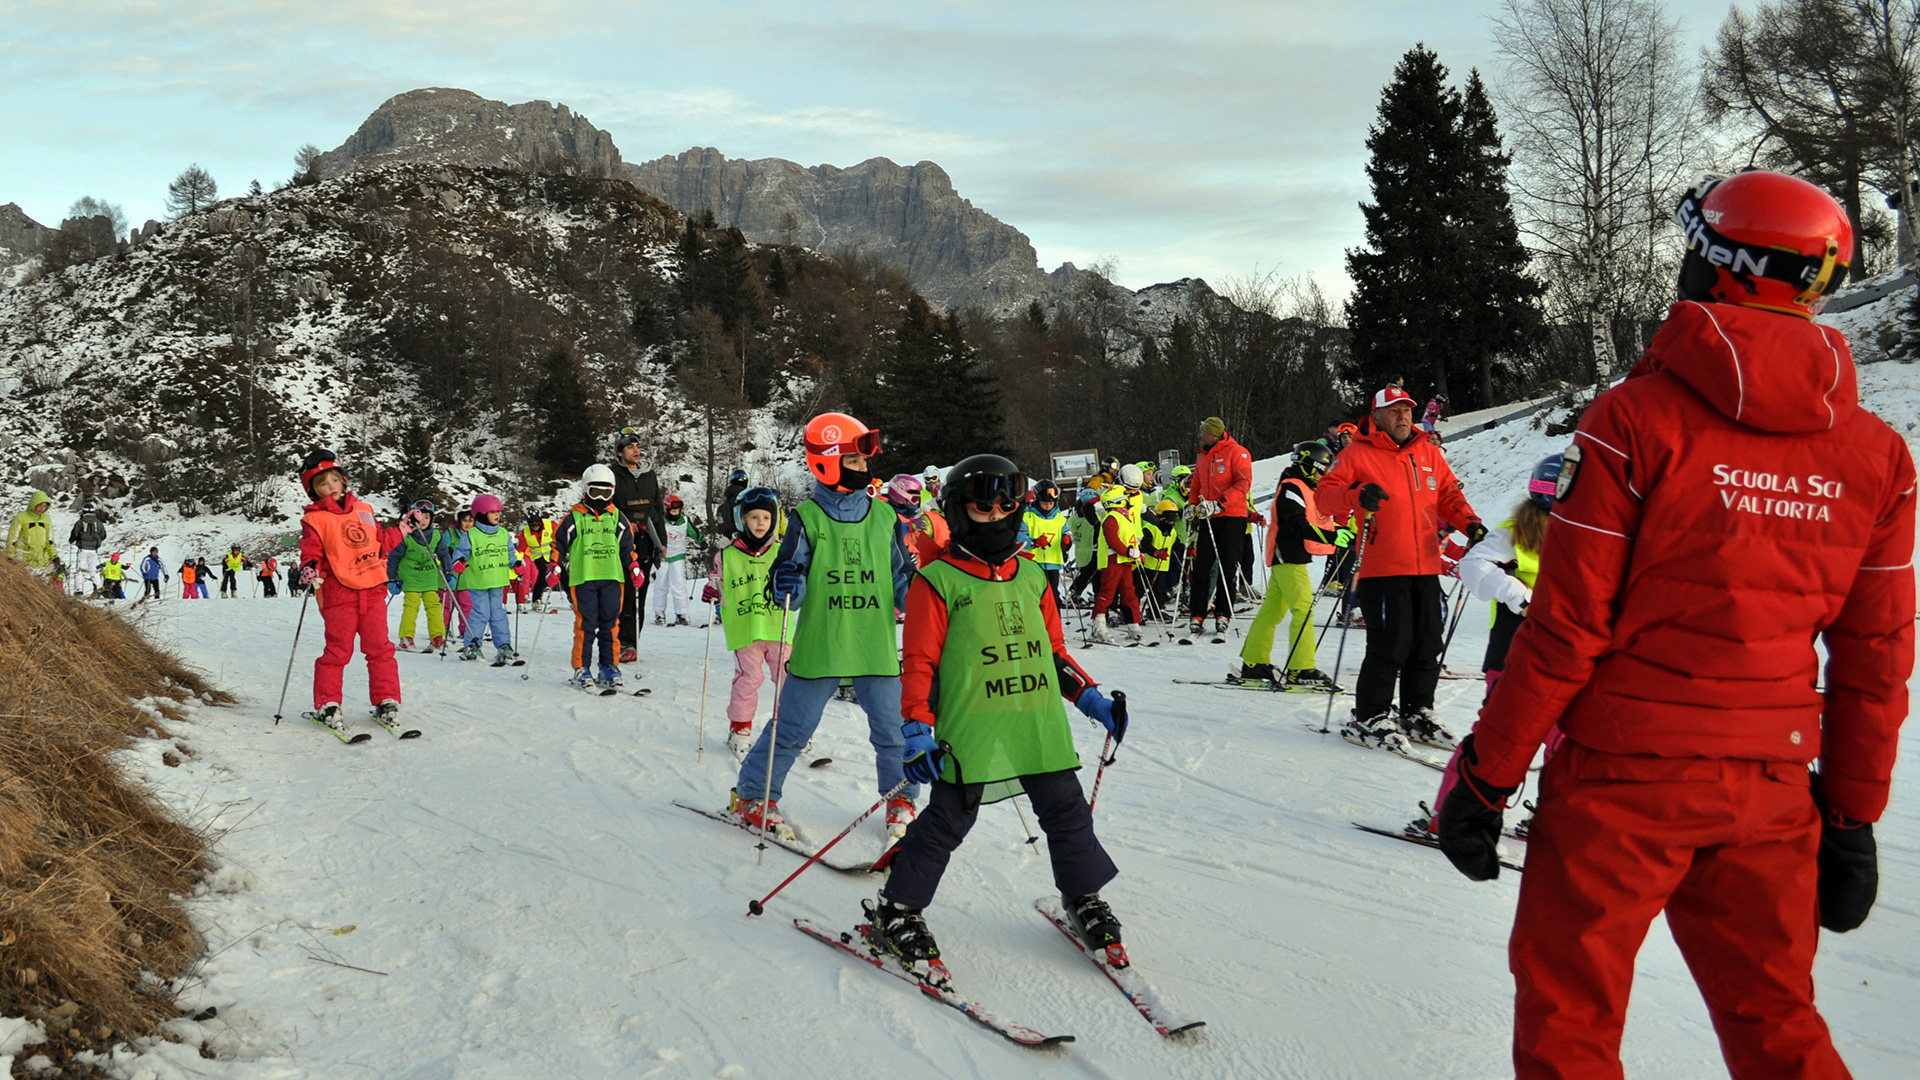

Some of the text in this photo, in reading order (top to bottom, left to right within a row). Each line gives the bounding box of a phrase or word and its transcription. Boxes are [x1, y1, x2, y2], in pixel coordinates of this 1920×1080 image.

[1701, 208, 1724, 225] vex
[1720, 489, 1830, 523] VALTORTA
[827, 570, 879, 585] S.E.M.
[828, 595, 880, 610] MEDA
[981, 640, 1045, 665] S.E.M.
[985, 672, 1049, 699] MEDA
